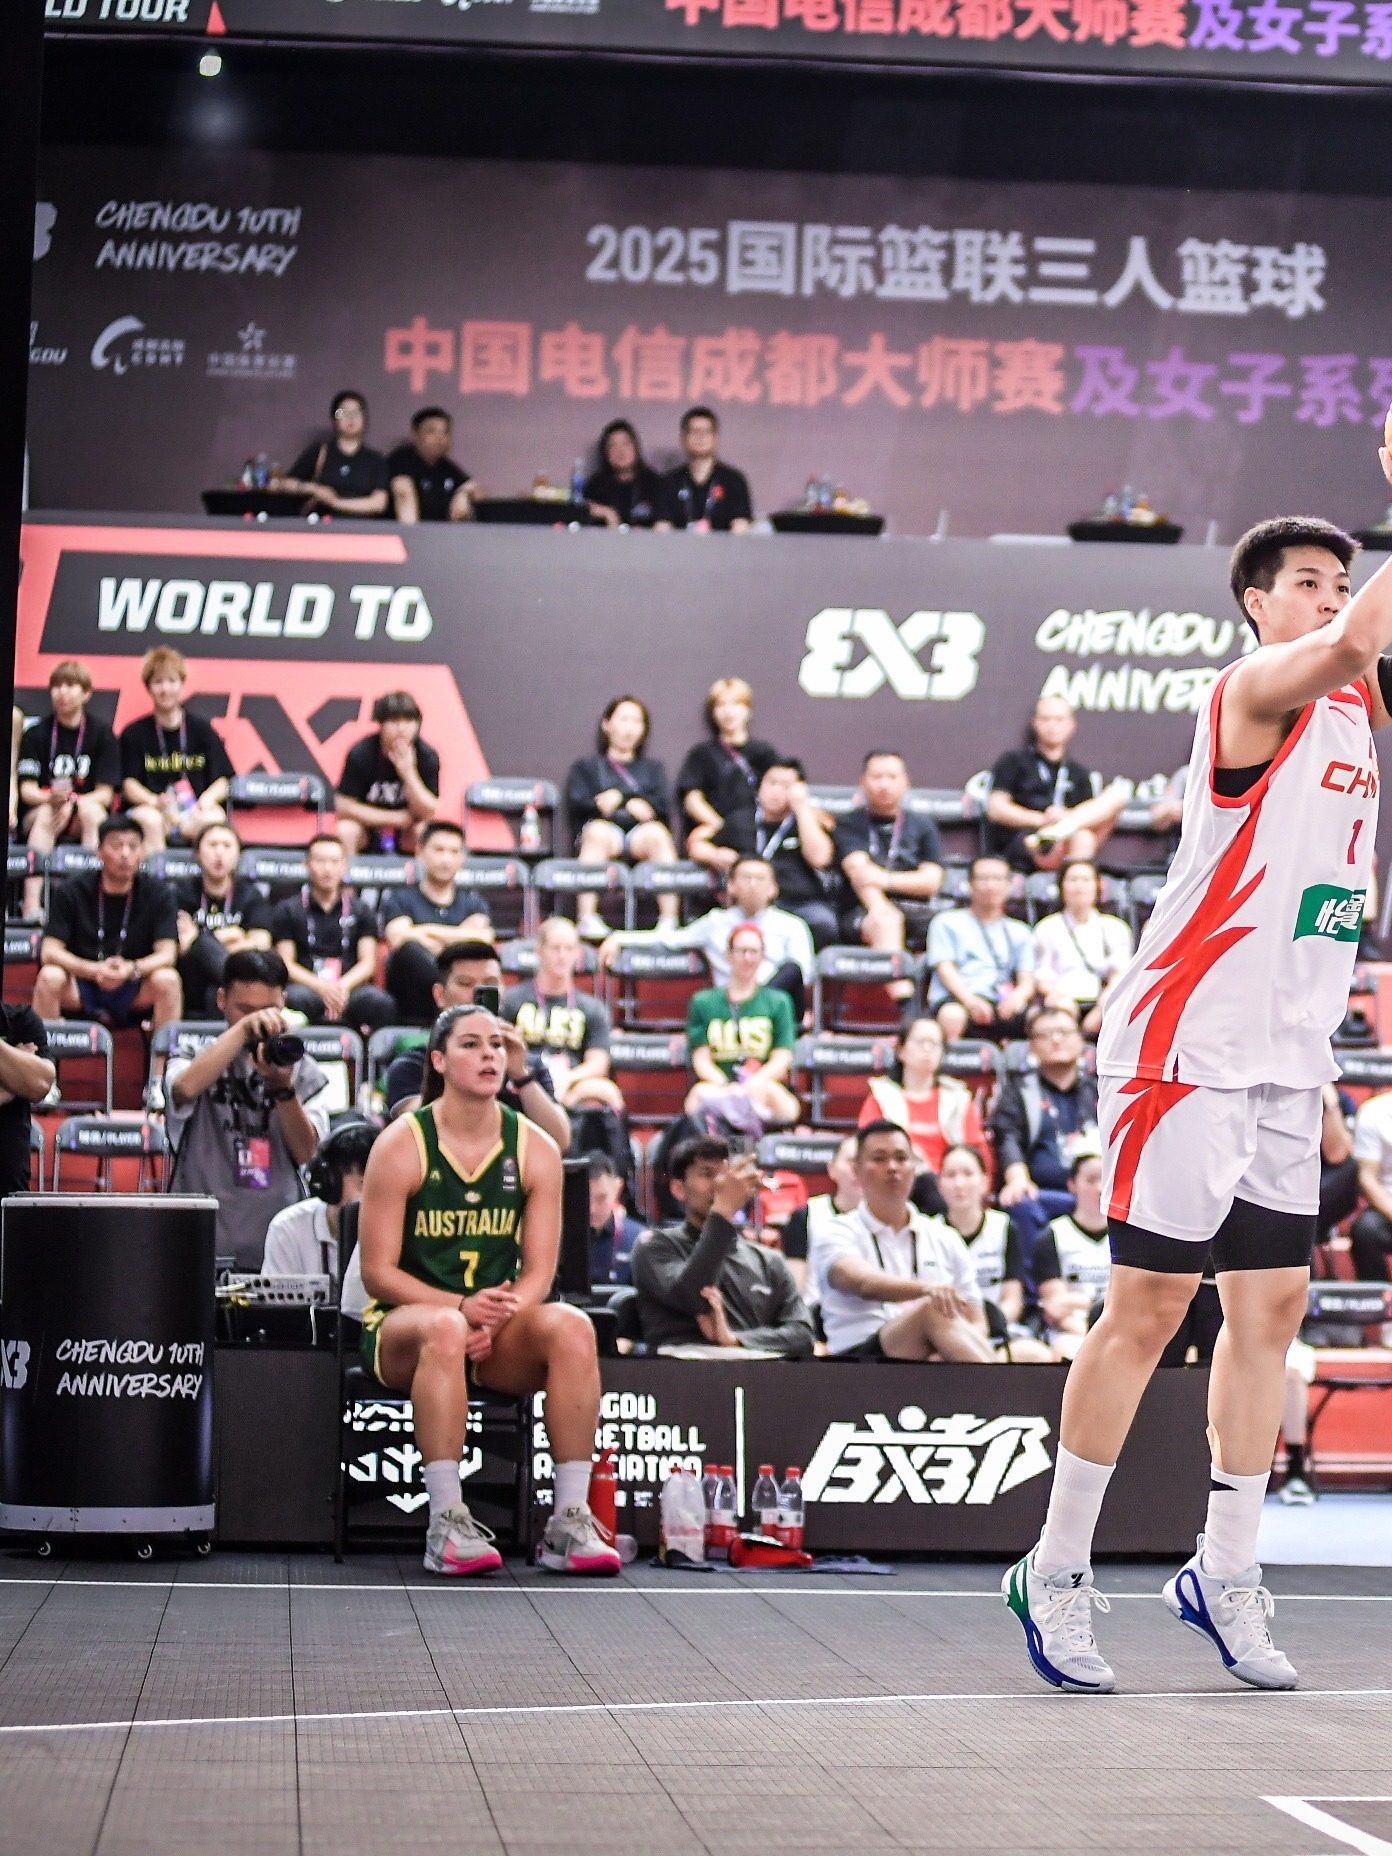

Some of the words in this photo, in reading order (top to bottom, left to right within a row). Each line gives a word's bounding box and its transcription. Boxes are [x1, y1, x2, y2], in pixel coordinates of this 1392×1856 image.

[95, 200, 232, 232] CHENGDU
[94, 238, 299, 278] ANNIVERSARY
[585, 222, 1328, 320] 2025国际篮联三人篮球
[98, 576, 335, 638] WORLD
[1034, 608, 1235, 658] CHENGDU
[1347, 818, 1364, 865] 1
[413, 1207, 516, 1238] AUSTRALIA
[459, 1250, 480, 1289] 7
[55, 1337, 165, 1365] CHENGDU
[55, 1370, 204, 1400] ANNIVERSARY
